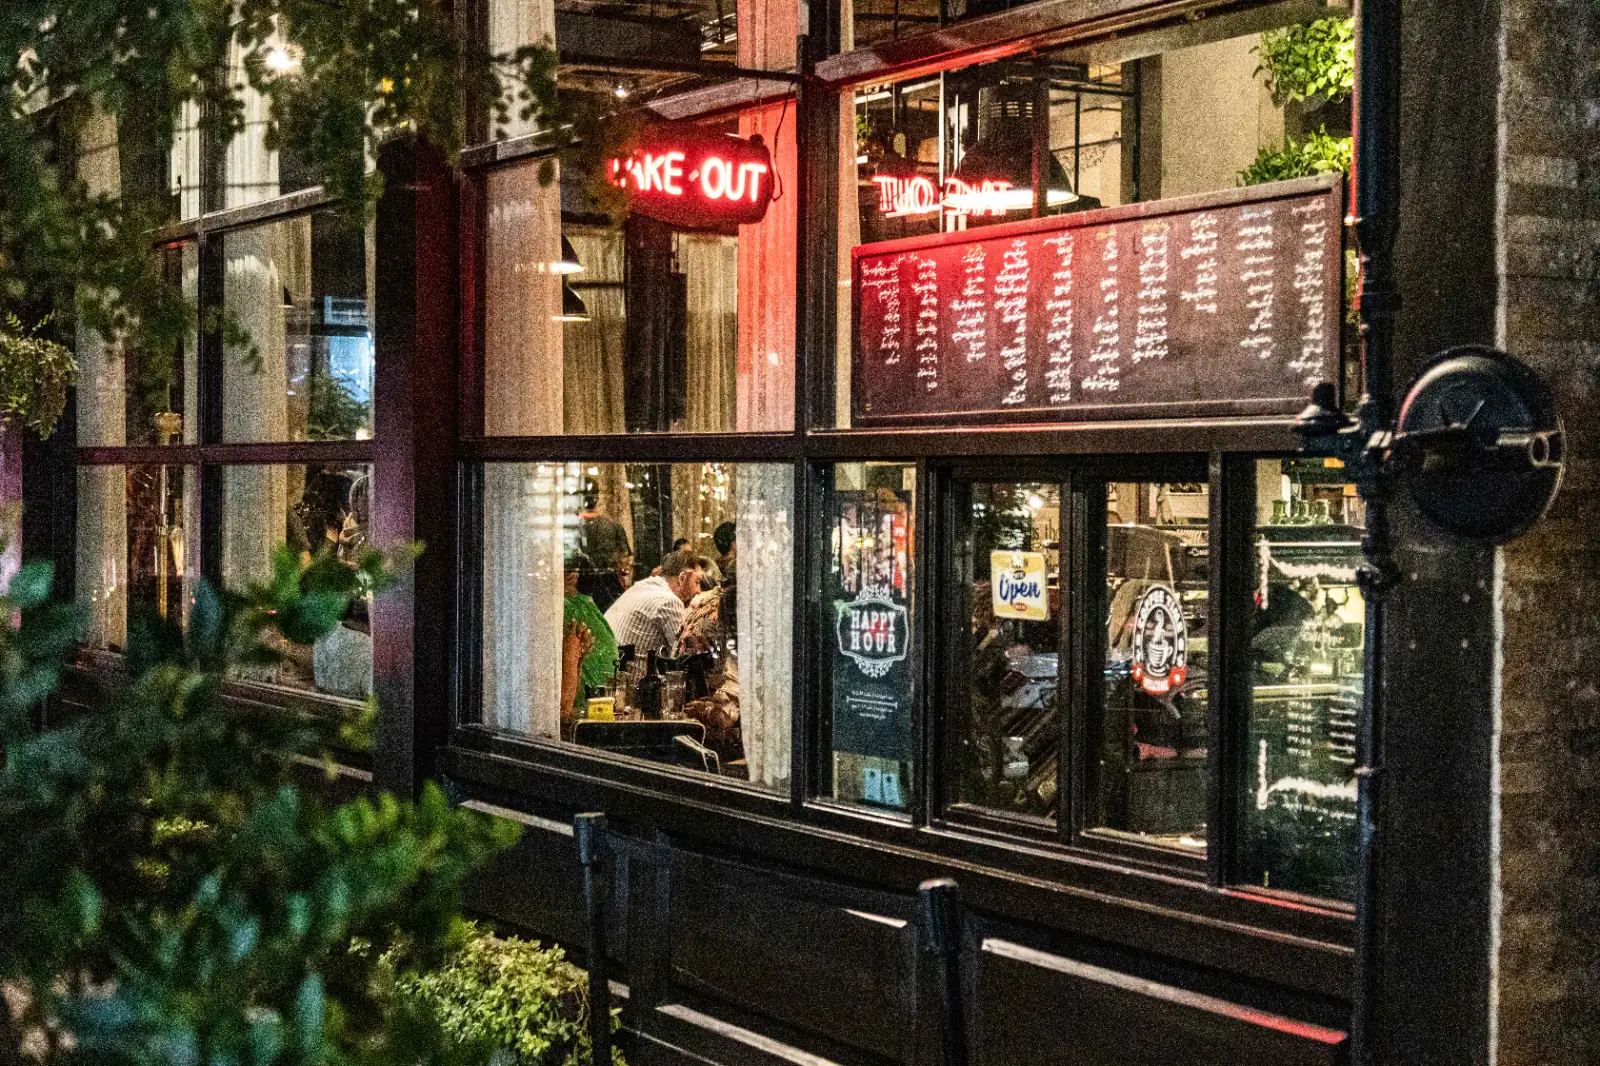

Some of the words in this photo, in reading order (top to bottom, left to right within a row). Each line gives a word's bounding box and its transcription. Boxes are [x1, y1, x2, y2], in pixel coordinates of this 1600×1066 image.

[999, 574, 1041, 606] Open
[850, 609, 896, 631] HAPPY
[850, 630, 896, 653] HOUR
